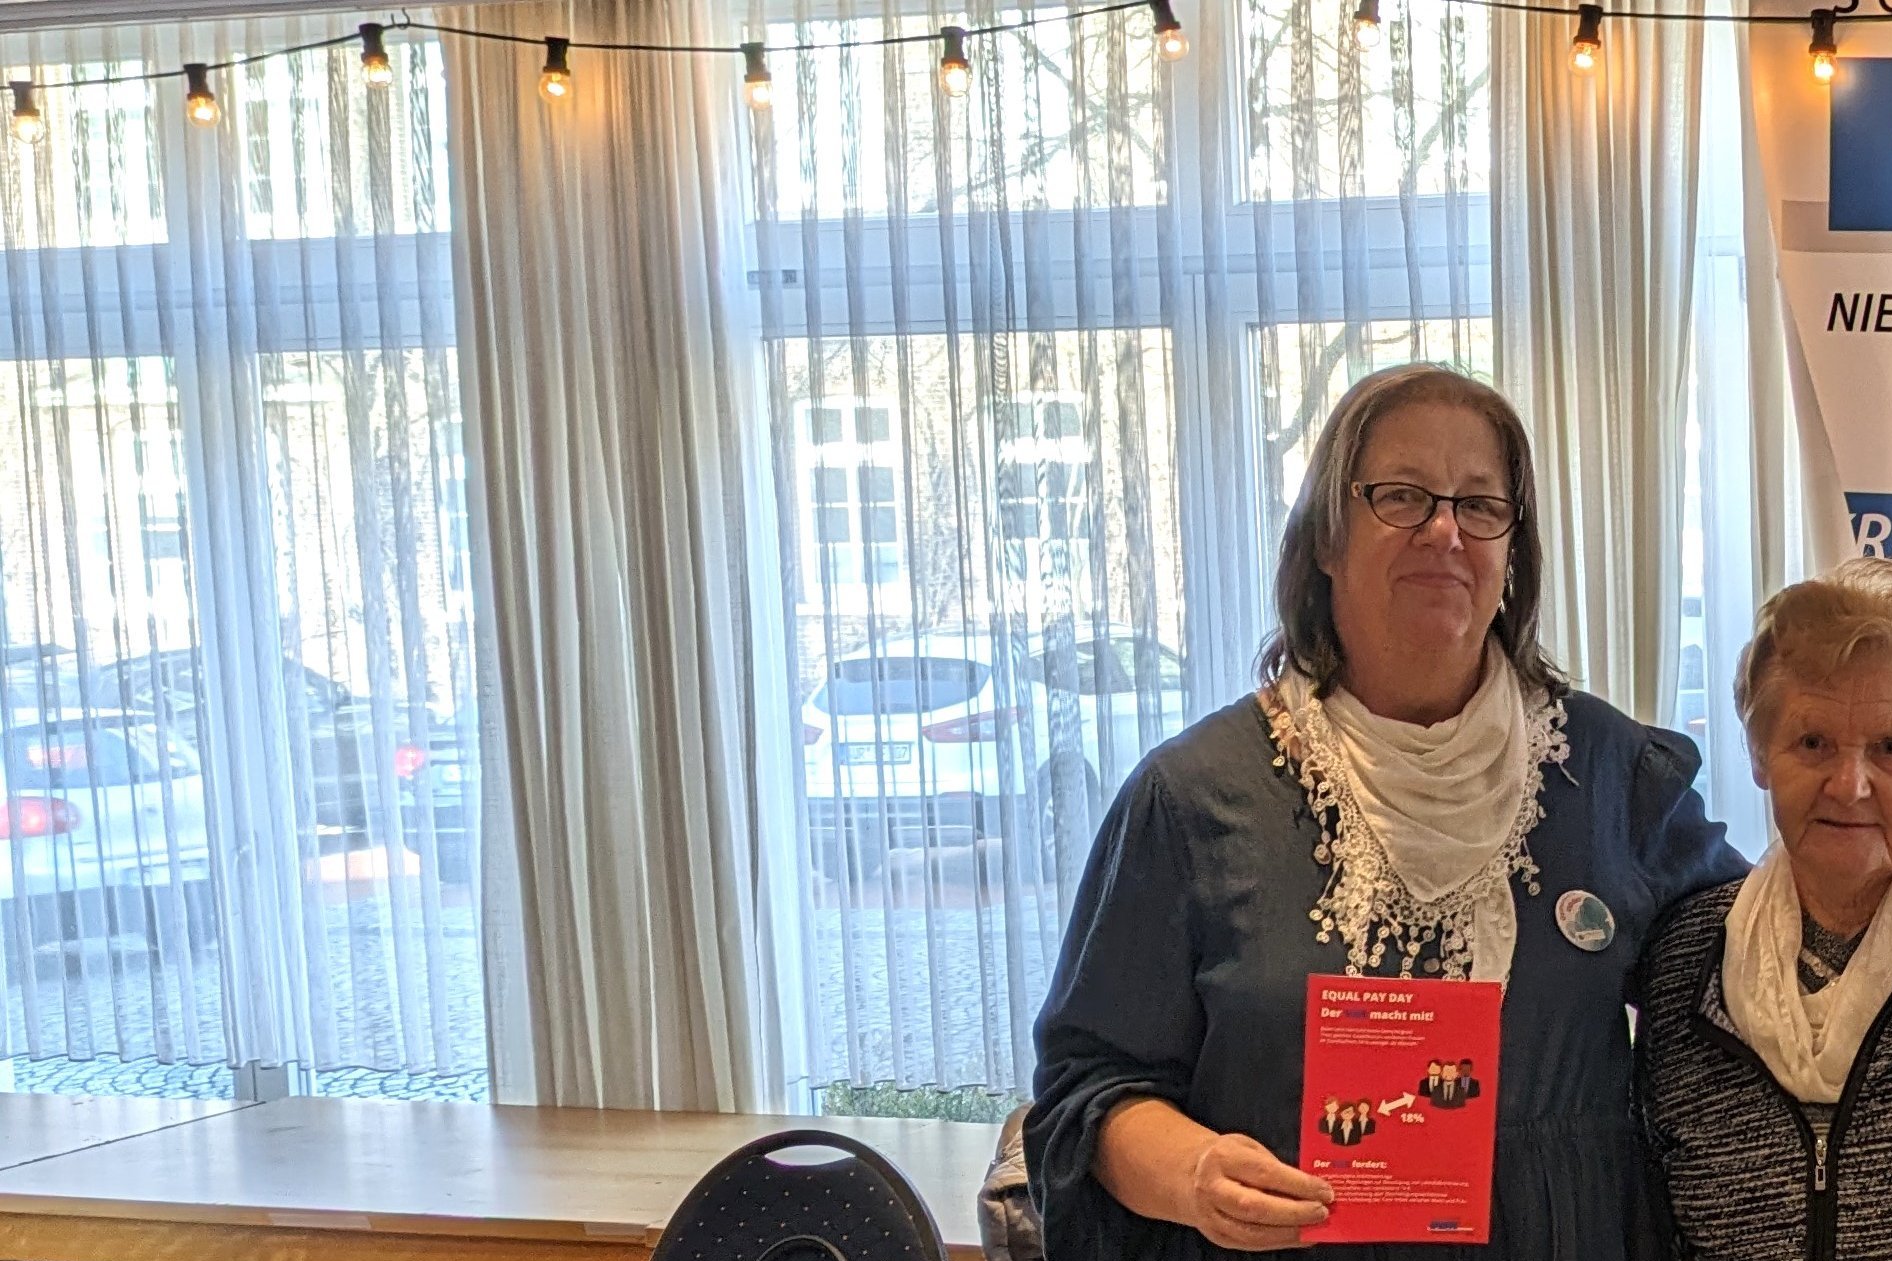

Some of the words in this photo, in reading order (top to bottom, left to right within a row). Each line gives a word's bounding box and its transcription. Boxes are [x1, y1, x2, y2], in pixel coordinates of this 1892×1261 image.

[1321, 989, 1361, 1003] EQUAL
[1362, 991, 1388, 1004] PAY
[1388, 992, 1414, 1004] DAY
[1320, 1006, 1343, 1019] Der
[1369, 1008, 1408, 1022] macht
